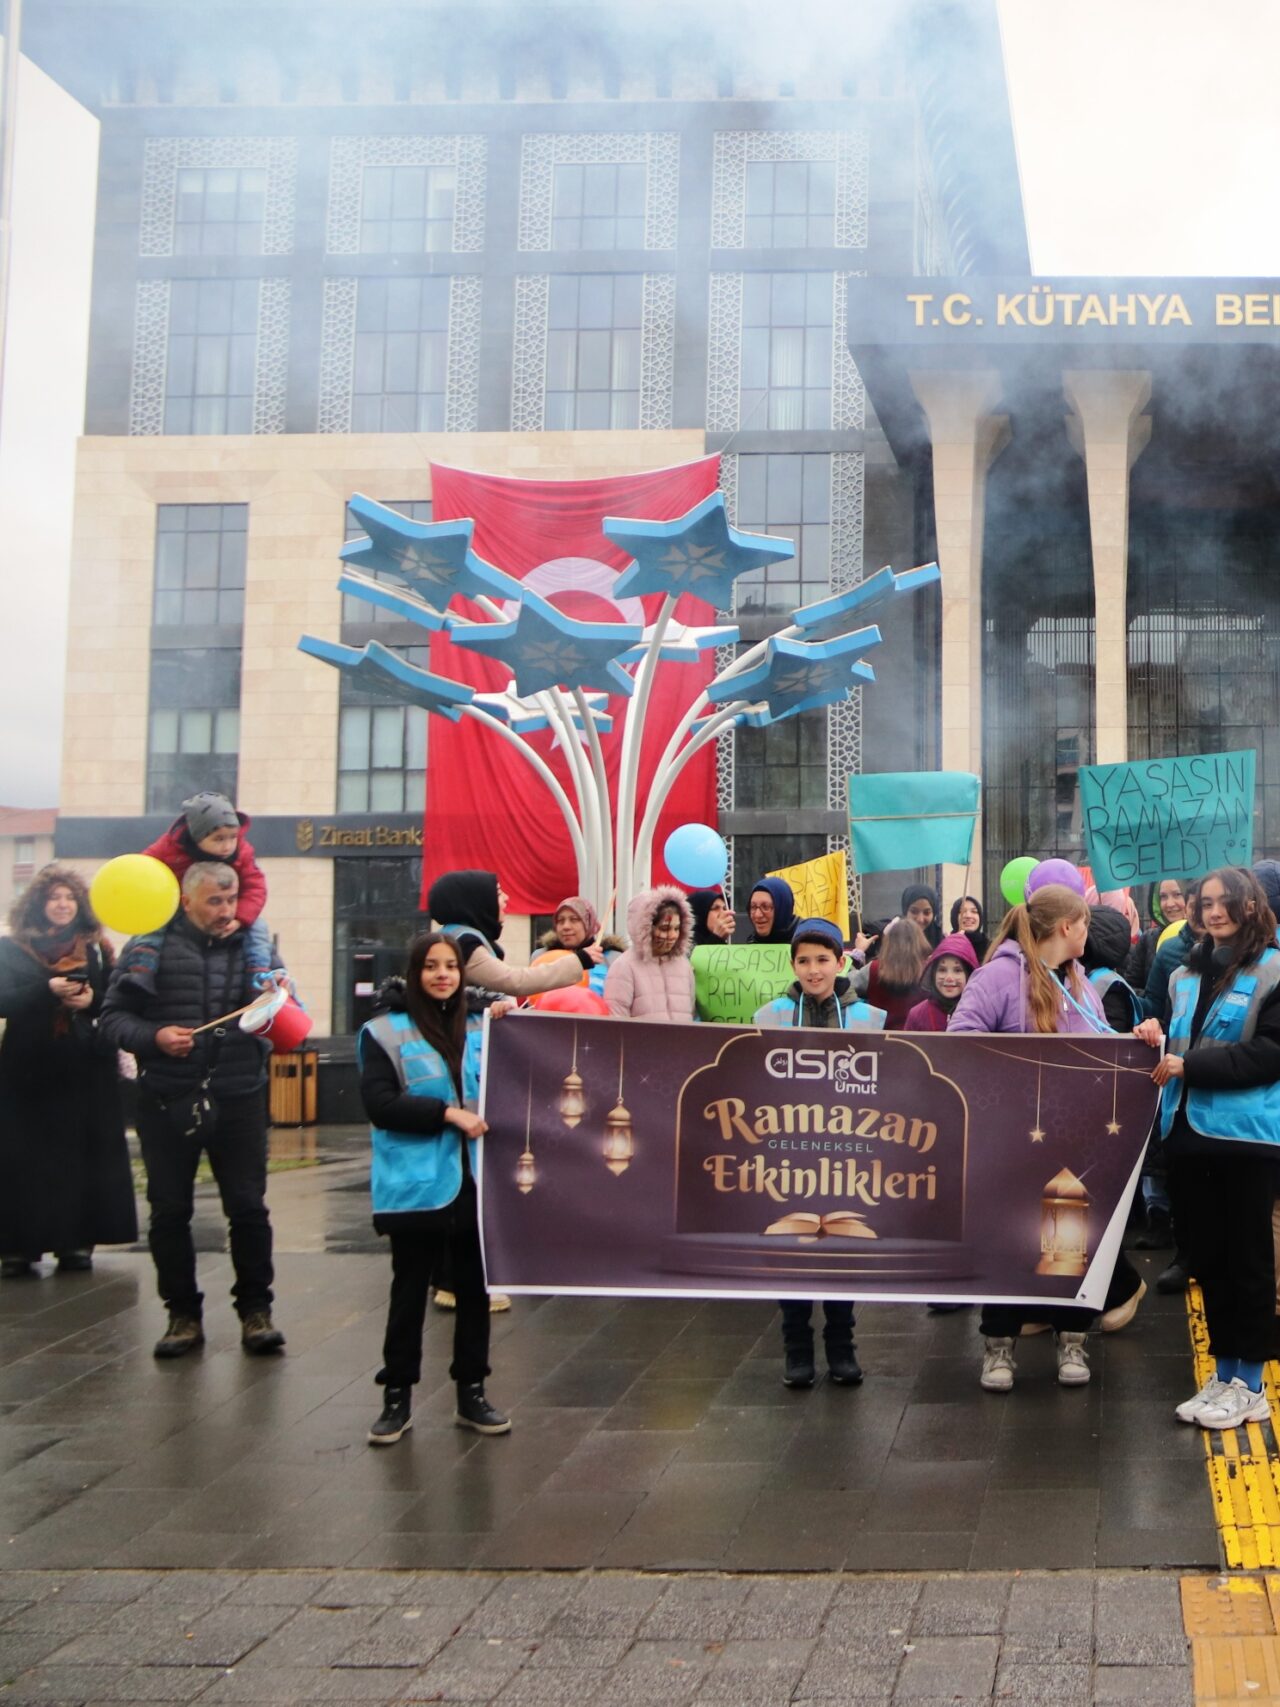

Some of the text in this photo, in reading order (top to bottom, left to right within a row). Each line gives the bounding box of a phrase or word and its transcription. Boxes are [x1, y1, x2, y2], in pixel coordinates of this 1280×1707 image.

[906, 293, 984, 326] T.C.
[996, 285, 1193, 326] KÜTAHYA
[1087, 757, 1245, 807] YAŞASIN
[318, 825, 425, 847] Ziraat Bank
[1086, 797, 1249, 850] RAMAZAN
[1108, 838, 1210, 882] GELDİ
[764, 1044, 878, 1082] asra
[834, 1080, 878, 1095] Umut
[703, 1097, 939, 1154] Ramazan
[767, 1139, 874, 1153] GELENEKSEL
[702, 1154, 938, 1206] Etkinlikleri
